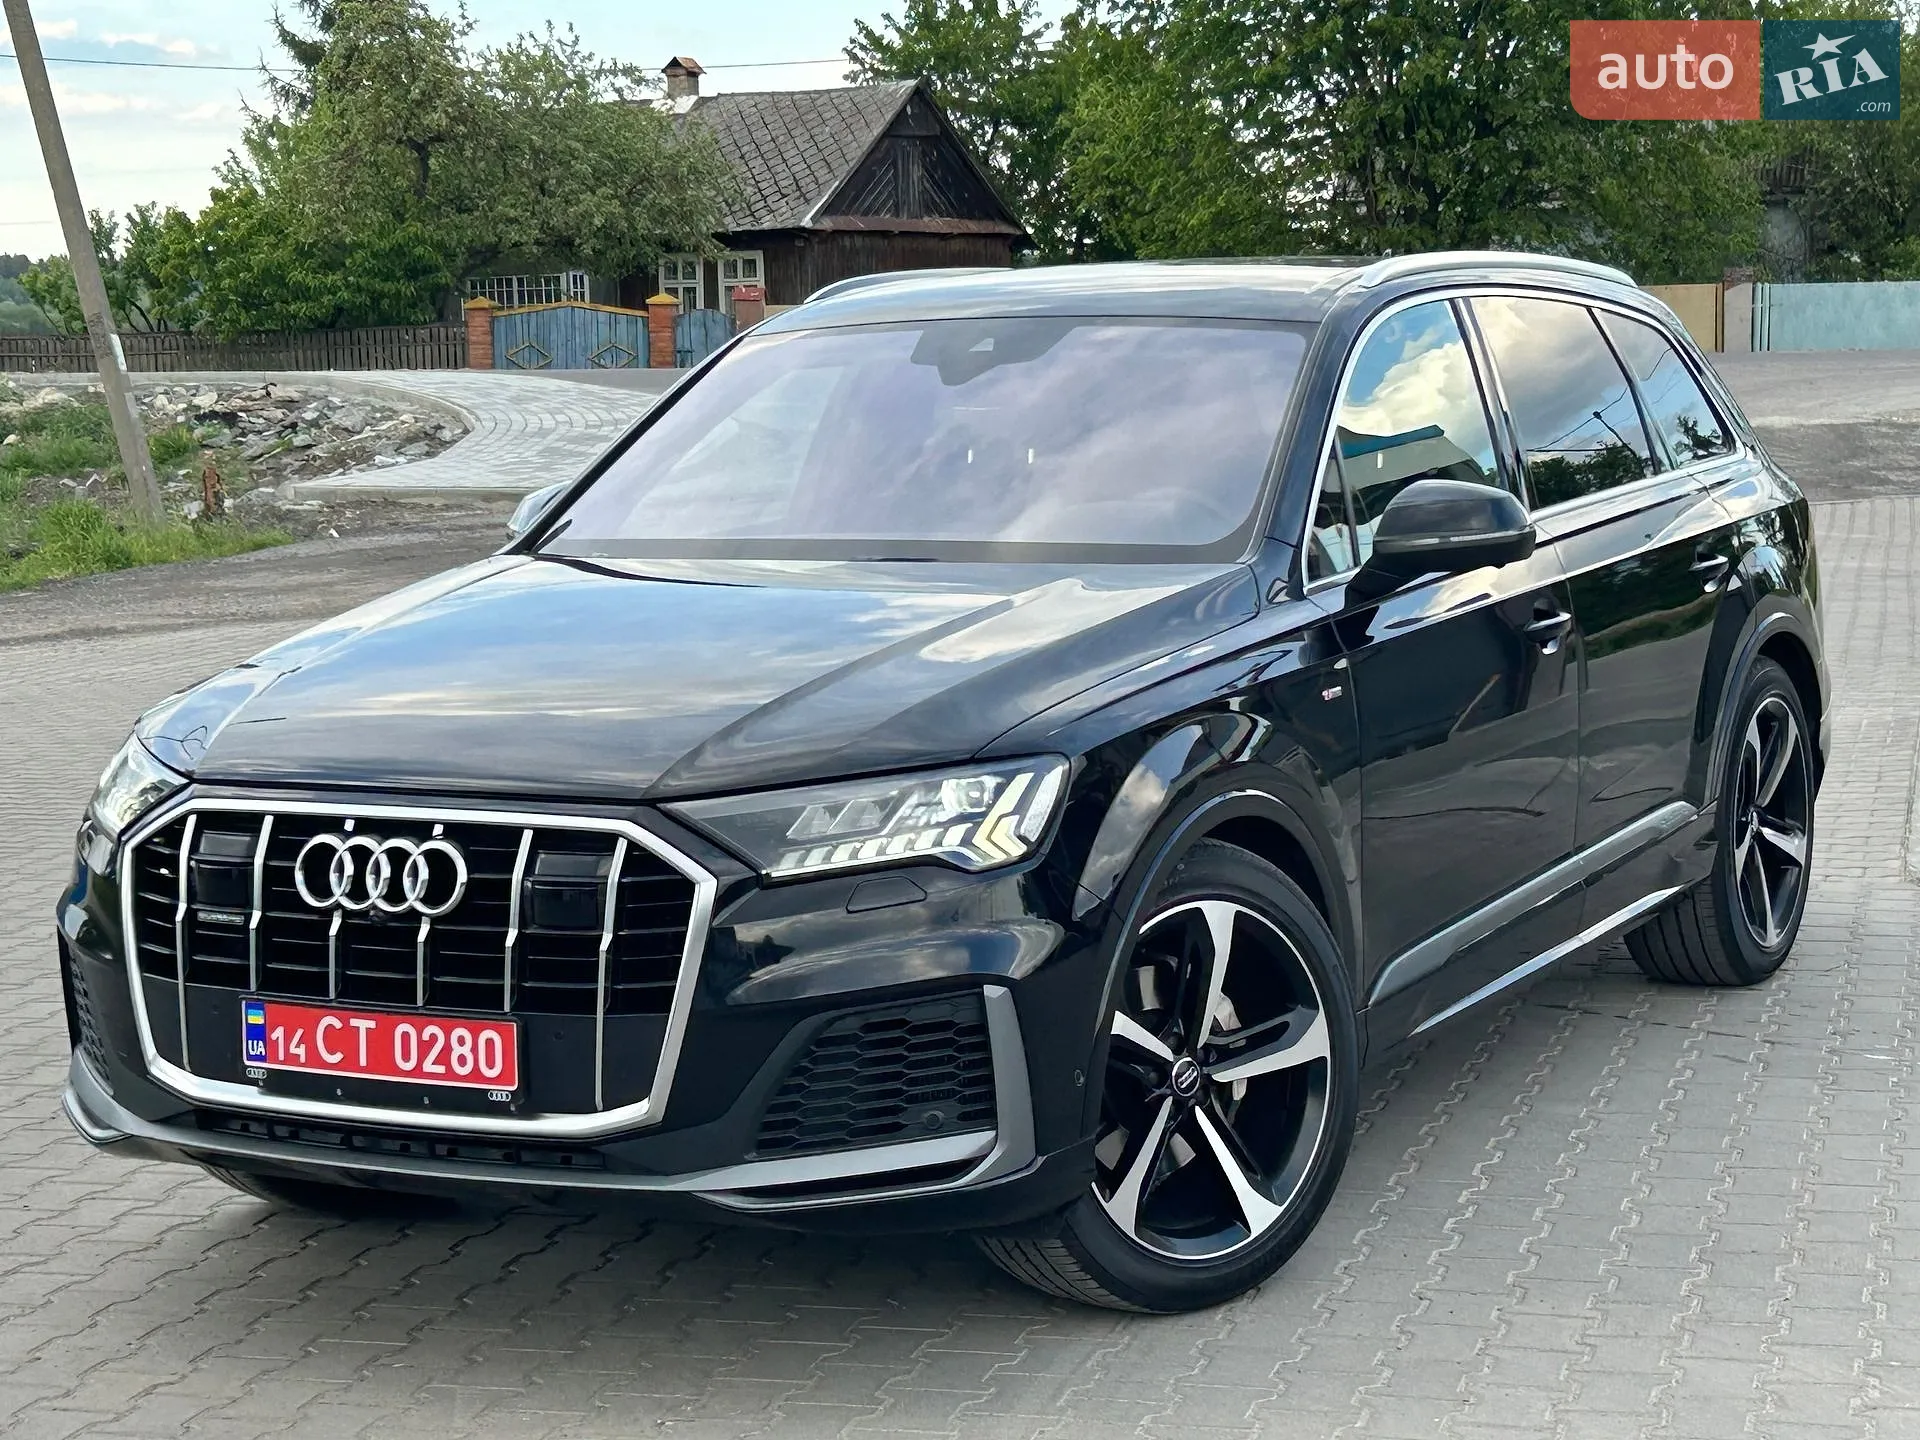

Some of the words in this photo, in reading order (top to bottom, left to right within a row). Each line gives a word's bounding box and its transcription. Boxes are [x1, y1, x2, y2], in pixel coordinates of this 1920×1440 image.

[247, 1039, 266, 1056] UA
[270, 1026, 306, 1064] 14
[315, 1015, 377, 1067] CT
[393, 1022, 503, 1078] 0280
